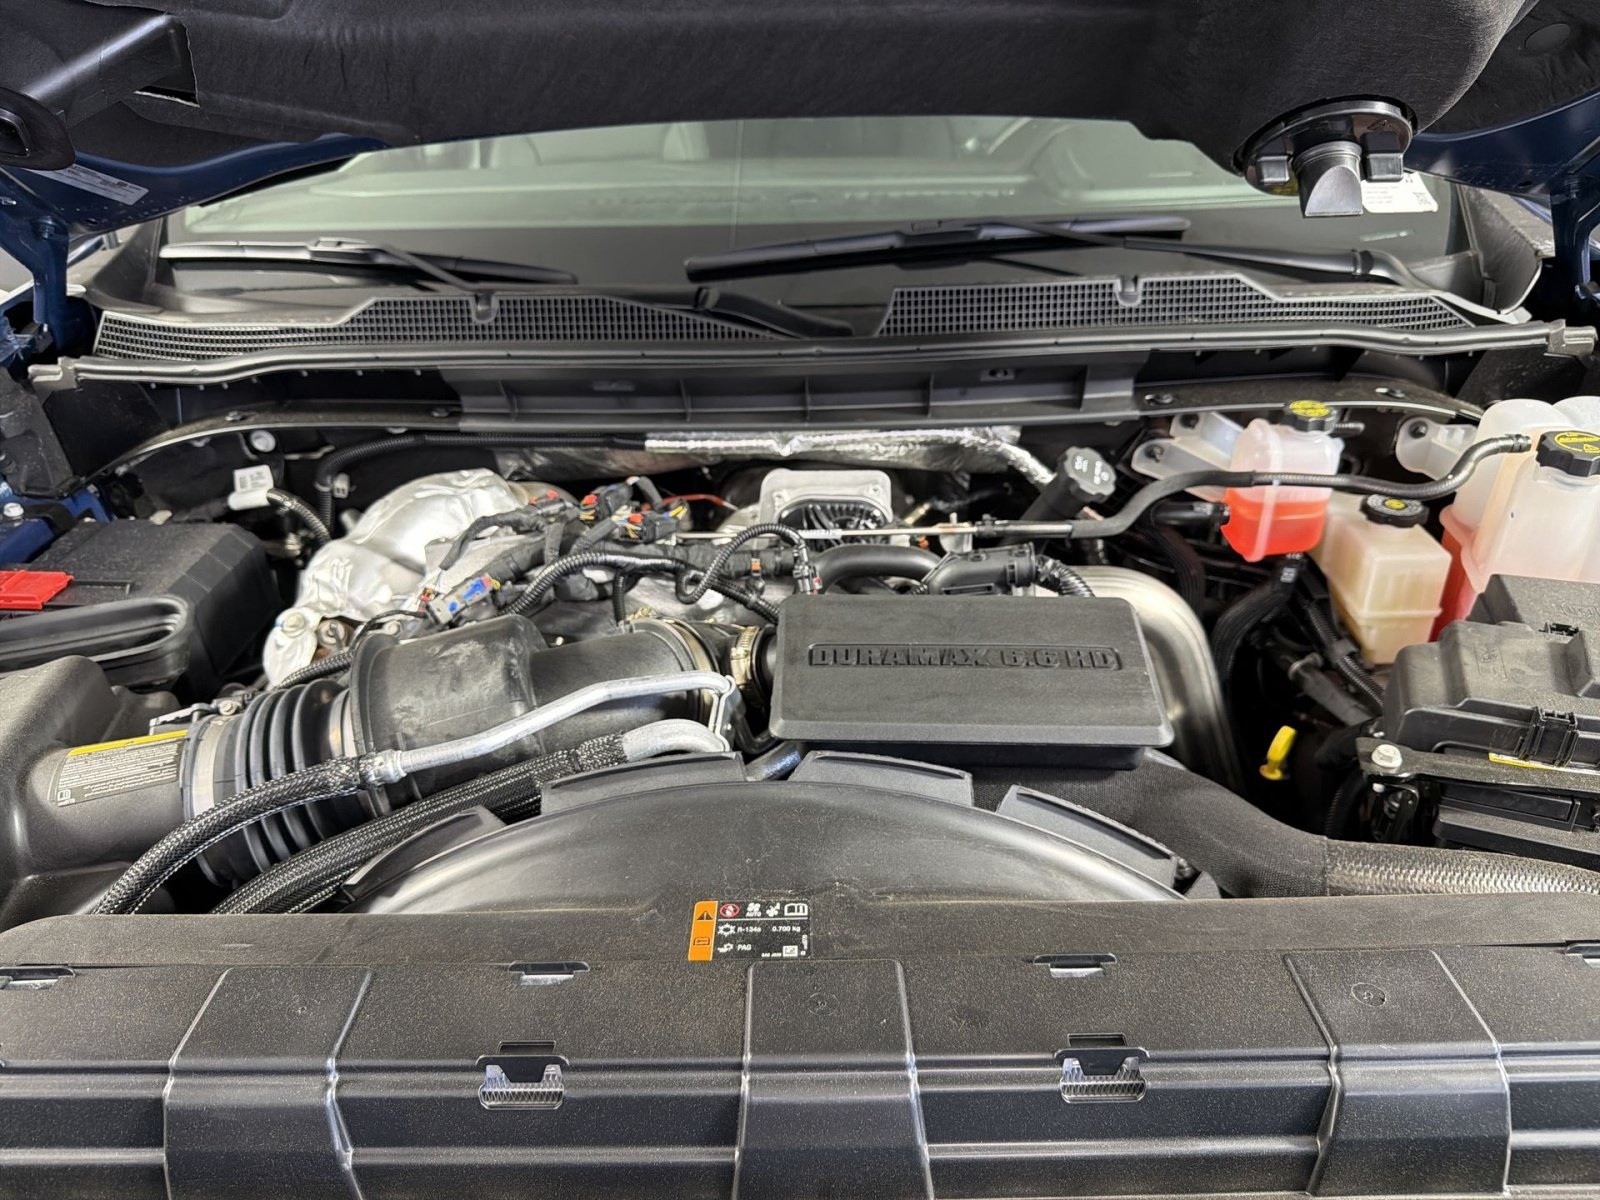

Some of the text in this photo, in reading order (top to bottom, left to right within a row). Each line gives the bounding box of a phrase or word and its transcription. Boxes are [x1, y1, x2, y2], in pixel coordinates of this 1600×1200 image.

[812, 648, 1118, 669] DURAMAX 6.6 HD
